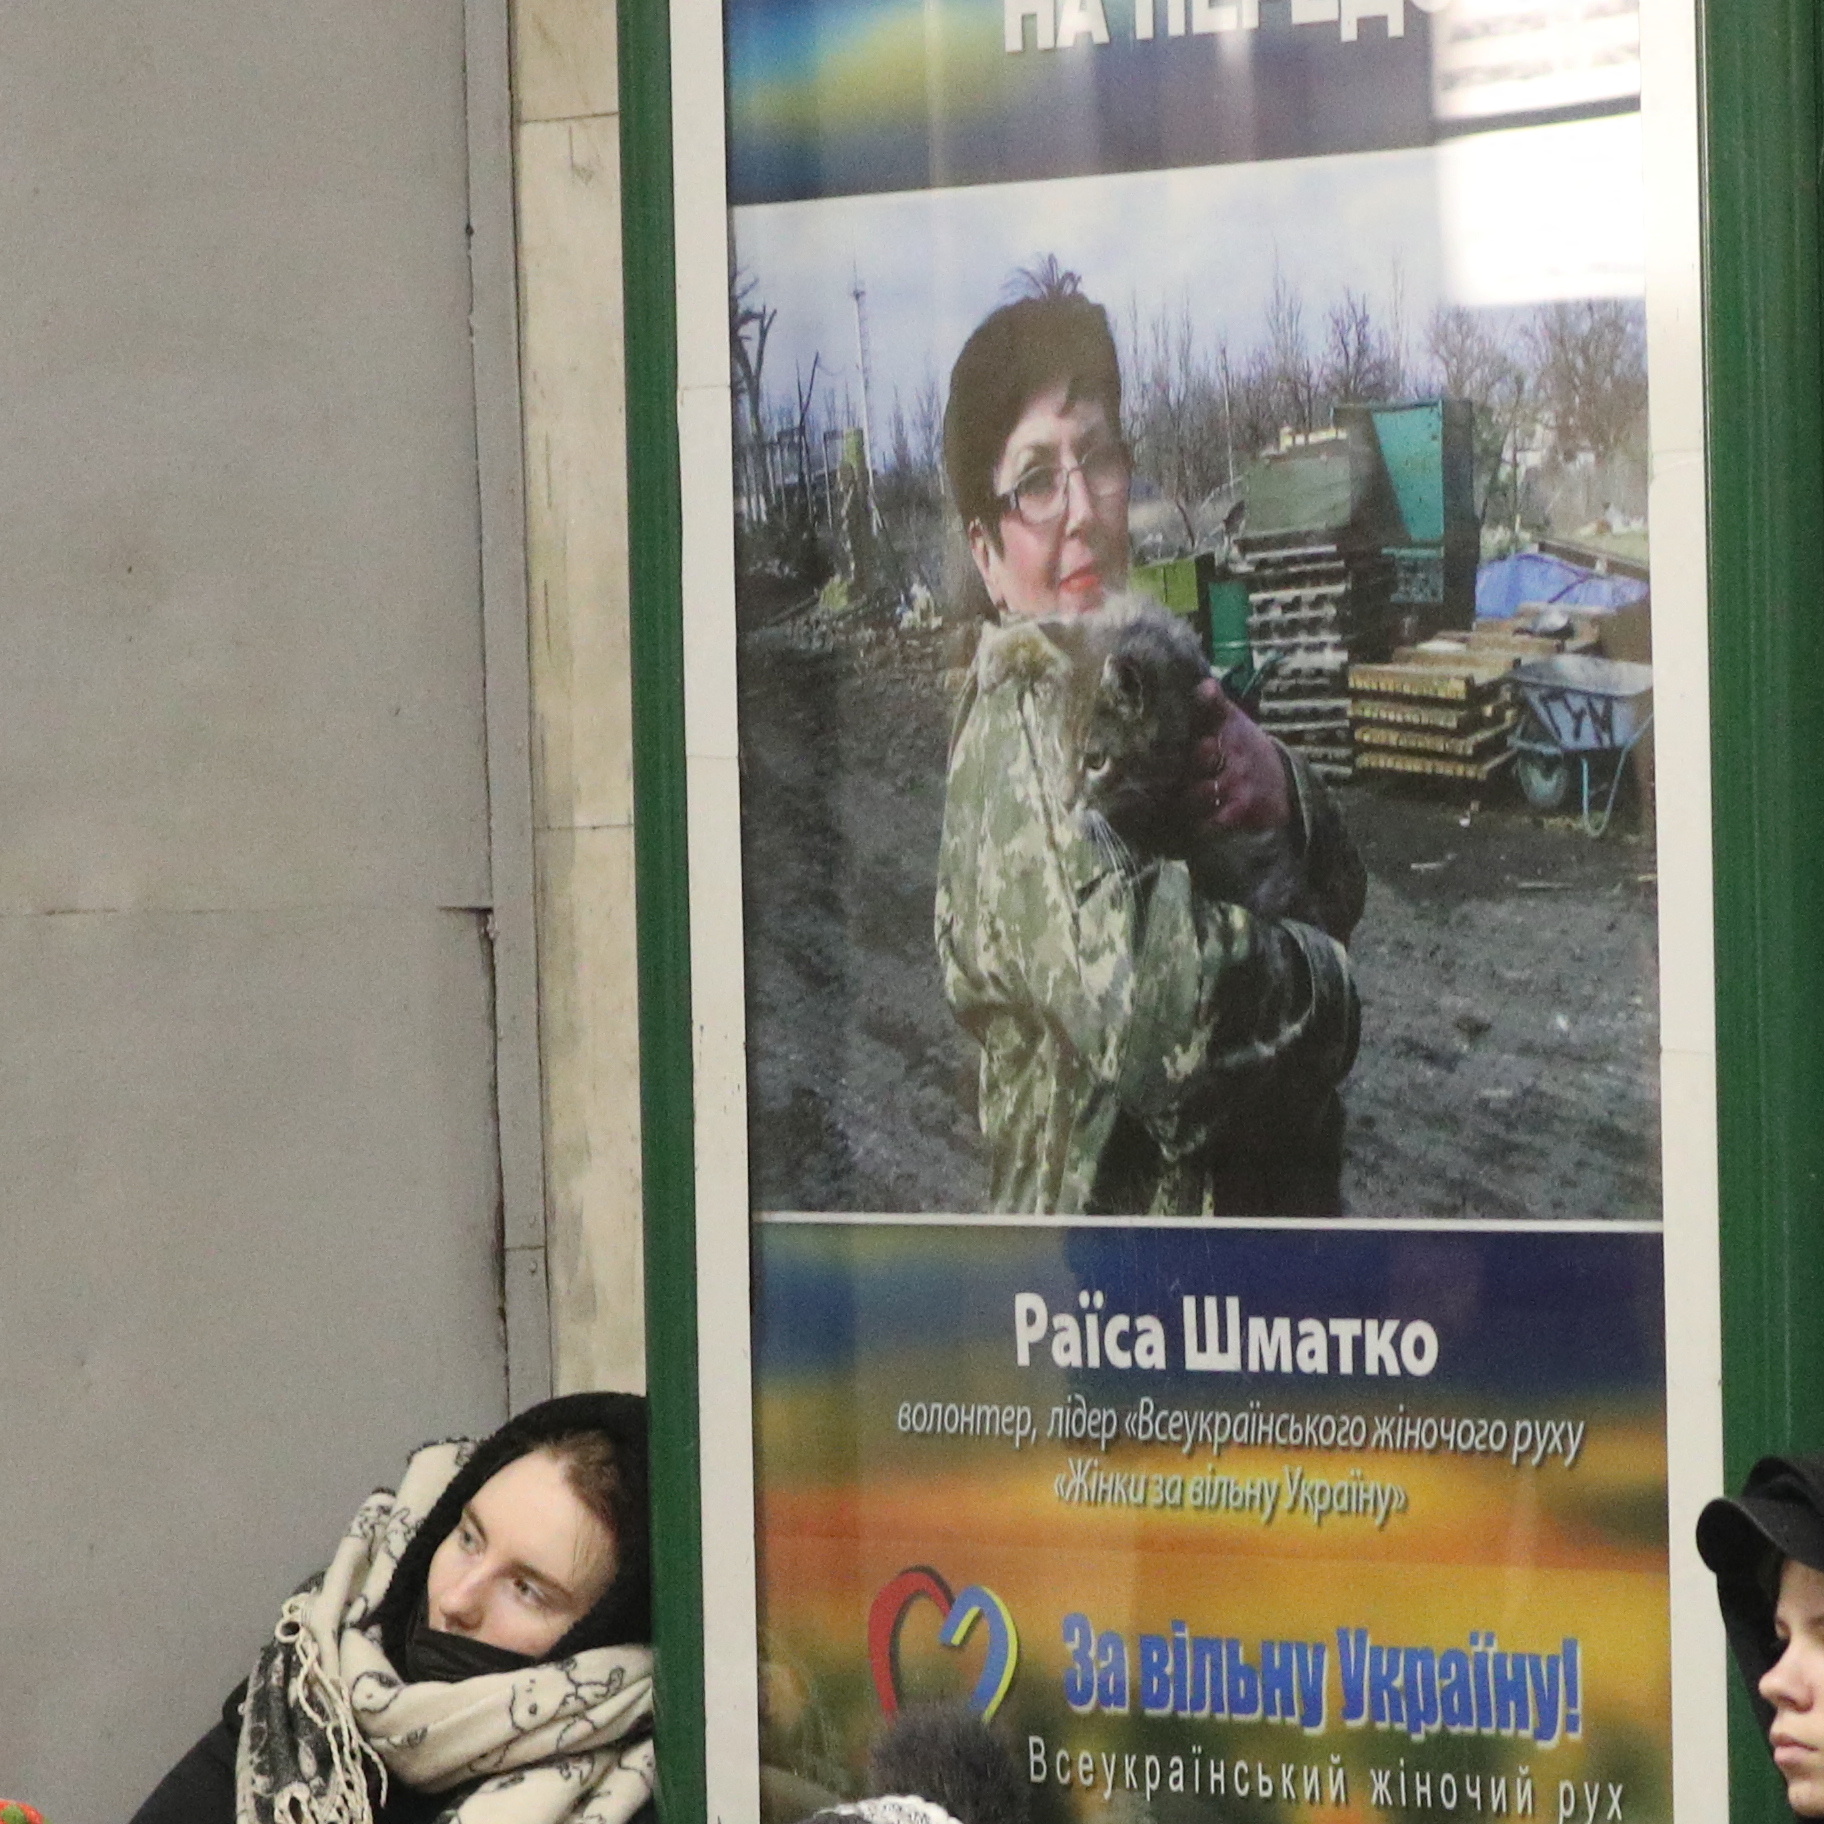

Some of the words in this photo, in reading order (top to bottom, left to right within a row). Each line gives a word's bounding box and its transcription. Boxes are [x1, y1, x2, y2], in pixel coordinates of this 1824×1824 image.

[1014, 1289, 1167, 1370] Раїса
[1182, 1294, 1439, 1377] Шматко
[896, 1399, 1038, 1451] волонтер,
[1046, 1393, 1118, 1452] лідер
[1125, 1395, 1368, 1456] «Всеукраїнського
[1370, 1403, 1508, 1452] жіночого
[1511, 1417, 1586, 1468] руху
[1053, 1456, 1146, 1508] «Жінки
[1150, 1472, 1184, 1507] за
[1188, 1462, 1281, 1527] вільну
[1282, 1463, 1410, 1530] Україну»
[1062, 1611, 1129, 1715] За
[1138, 1619, 1327, 1736] вільну
[1336, 1626, 1583, 1748] Україну!
[1027, 1734, 1350, 1803] Всеукраїнський
[1370, 1758, 1537, 1819] жіночий
